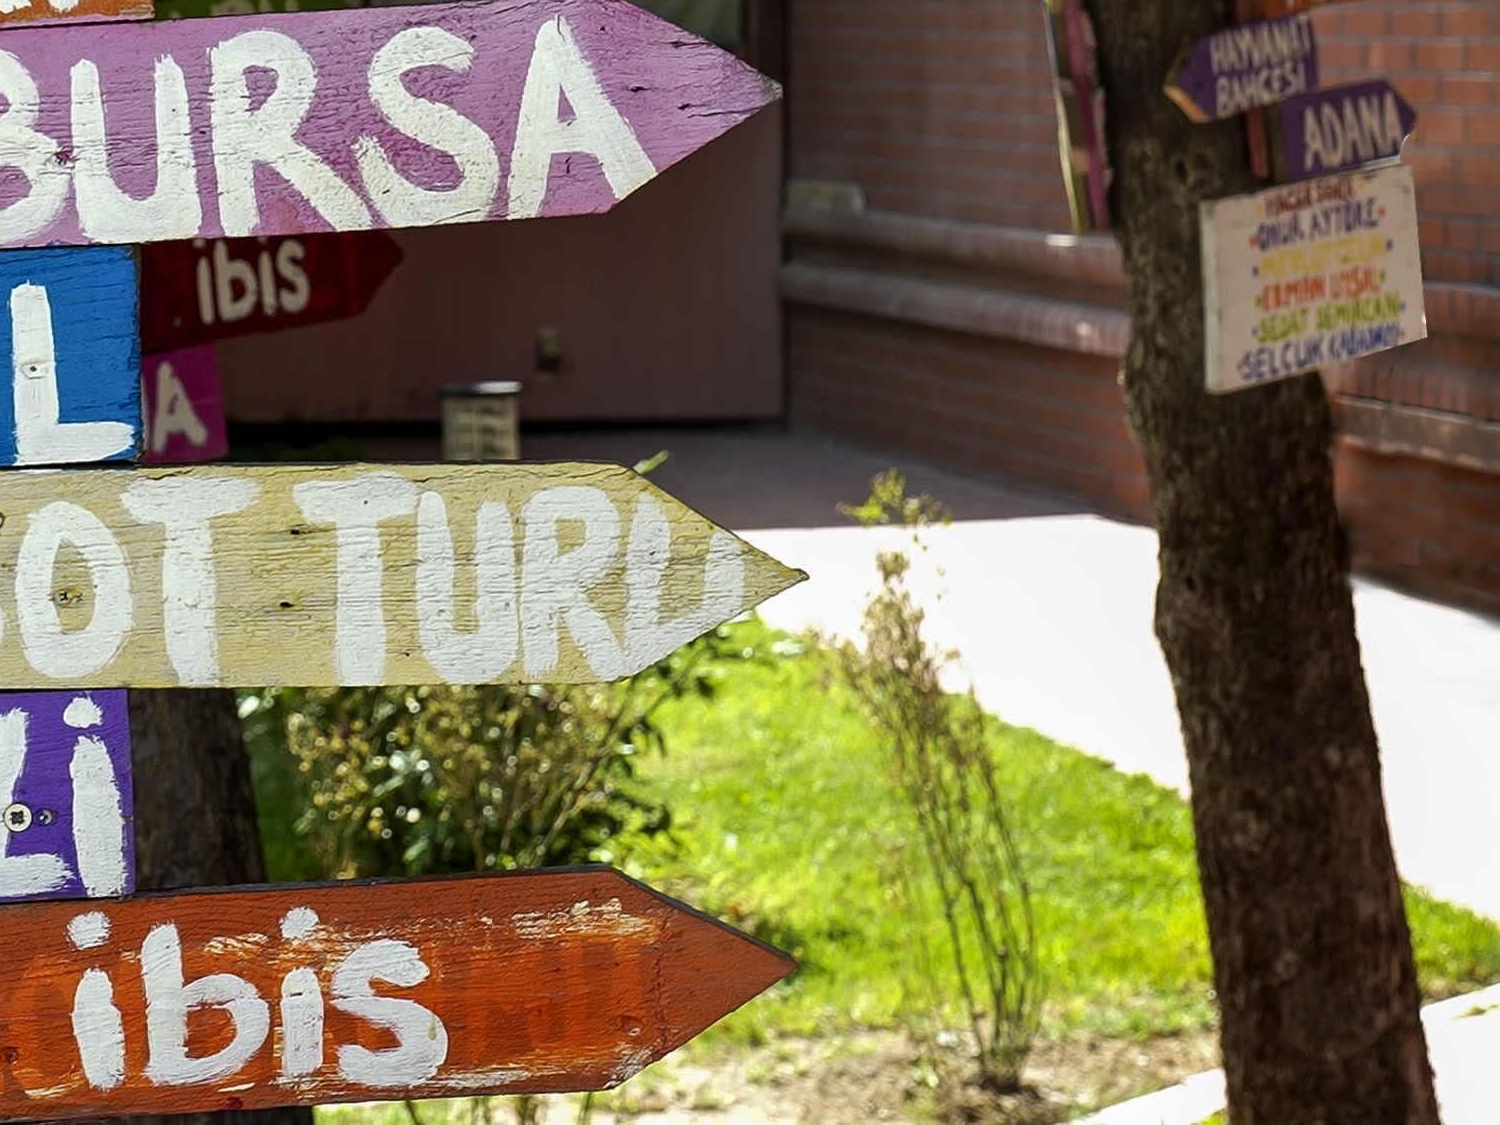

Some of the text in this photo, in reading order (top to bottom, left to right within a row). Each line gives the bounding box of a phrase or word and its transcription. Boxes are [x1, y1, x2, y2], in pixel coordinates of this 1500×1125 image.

[1304, 90, 1400, 170] ADANA
[193, 237, 311, 324] ibis
[294, 471, 746, 686] TURU
[66, 906, 449, 1089] ibis
